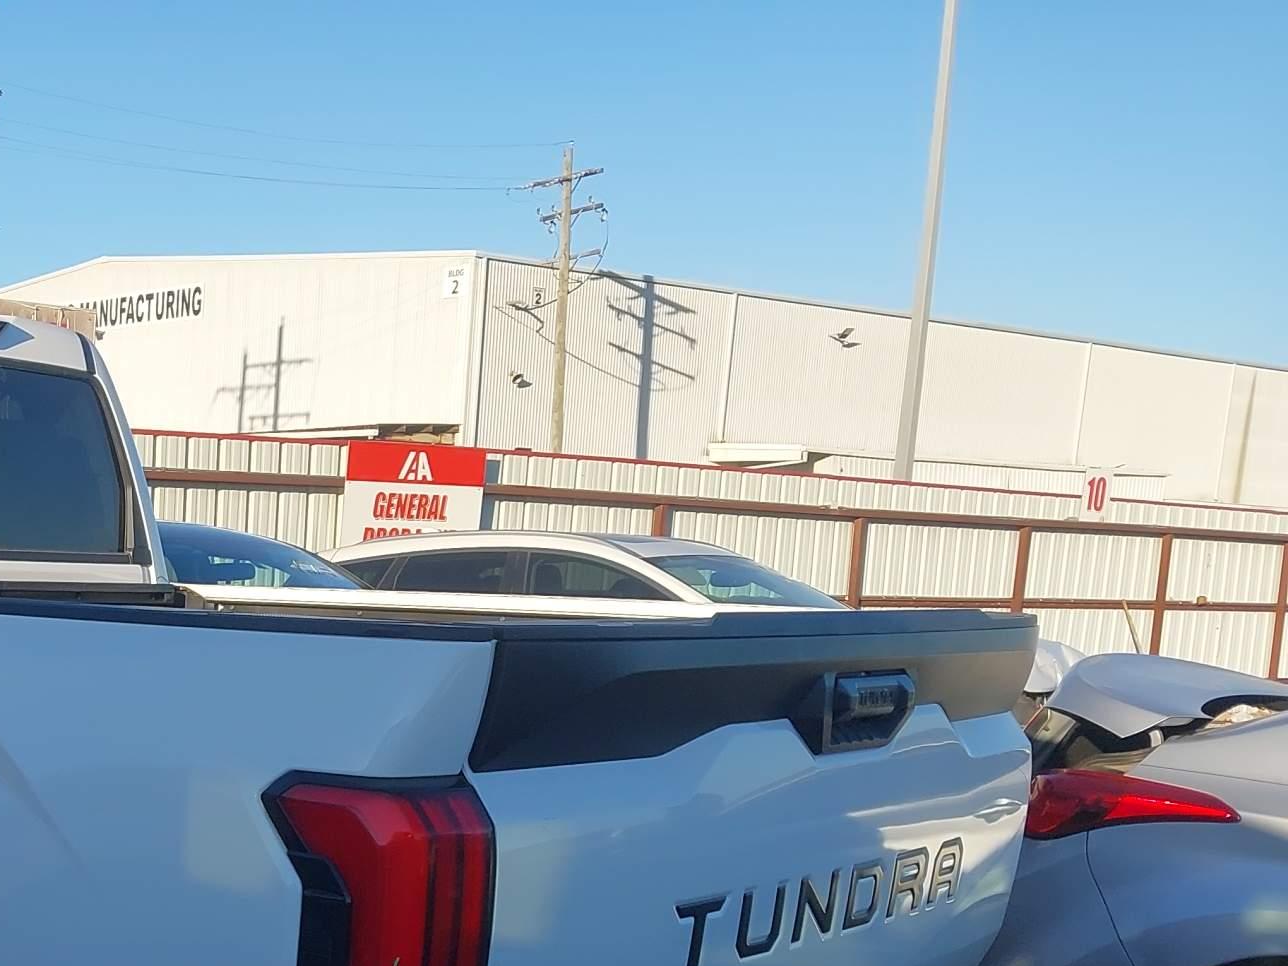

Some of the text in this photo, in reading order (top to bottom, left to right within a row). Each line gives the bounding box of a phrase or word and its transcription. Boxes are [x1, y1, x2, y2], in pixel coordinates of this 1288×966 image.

[451, 280, 459, 294] 2
[535, 293, 542, 304] 2
[80, 286, 202, 328] ANUFACTURING
[373, 492, 448, 520] GENERAL
[1087, 477, 1107, 511] 10
